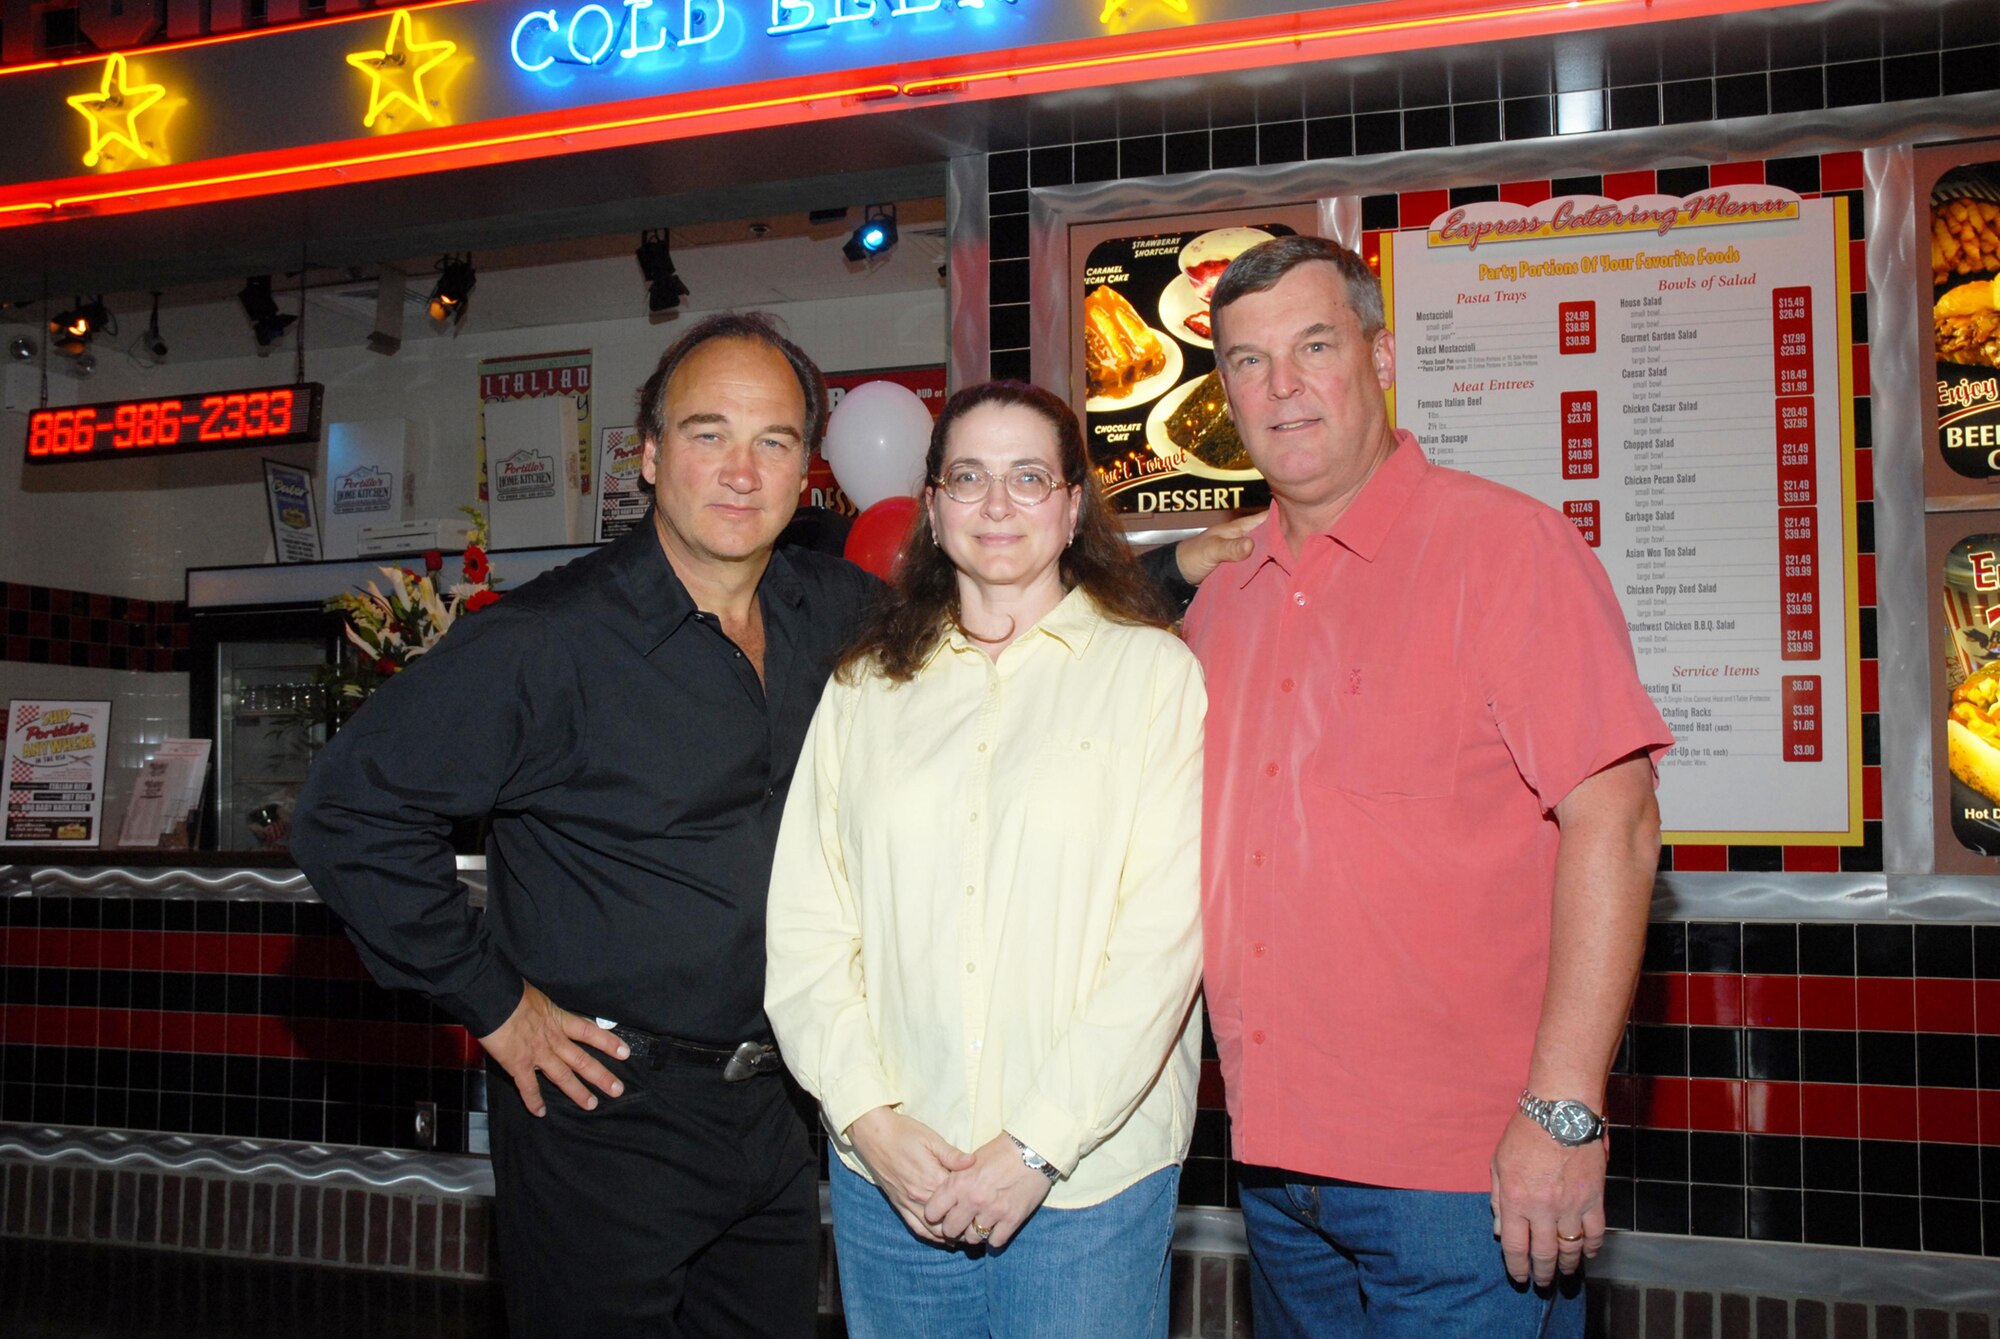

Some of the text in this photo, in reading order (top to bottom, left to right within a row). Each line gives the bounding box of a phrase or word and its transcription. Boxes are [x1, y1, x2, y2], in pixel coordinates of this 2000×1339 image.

[510, 0, 726, 72] COLD
[1440, 192, 1788, 251] Express Catering Menu
[1132, 237, 1182, 250] STRAWBERRY
[1134, 246, 1180, 258] SHORTCAKE
[1479, 246, 1740, 281] Party Portions Of Your Favorite Foods
[1086, 266, 1122, 276] CARAMEL
[1108, 274, 1130, 284] CAKE
[1658, 273, 1756, 292] Bowls of Salad
[1456, 290, 1527, 304] Pasta Trays
[1620, 296, 1662, 308] House Salad
[1779, 297, 1804, 308] $15.49
[1416, 310, 1453, 321] Mostaccioli
[1565, 311, 1590, 322] $24.99
[1779, 308, 1804, 320] $26.49
[1565, 322, 1590, 332] $38.99
[1566, 336, 1590, 346] $30.99
[1621, 330, 1697, 344] Gourmet Garden Salad
[1782, 333, 1806, 344] $17.99
[1416, 344, 1476, 355] Baked Mostaccioli
[1780, 345, 1806, 356] $29.99
[1622, 367, 1667, 379] Caesar Salad
[1782, 369, 1806, 380] $18.49
[1452, 379, 1534, 393] Meat Entrees
[1782, 382, 1807, 392] $31.99
[1937, 378, 1998, 407] Enjoy
[1418, 396, 1482, 408] Famous Italian Beef
[1572, 402, 1592, 412] $9.49
[1623, 401, 1698, 414] Chicken Caesar Salad
[1567, 412, 1592, 424] $23.70
[1782, 407, 1807, 418] $20.49
[29, 389, 293, 457] 866-986-2333
[1094, 423, 1142, 434] CHOCOLATE
[1784, 418, 1808, 429] $37.99
[1107, 432, 1130, 442] CAKE
[1418, 434, 1468, 444] Italian Sausage
[1568, 438, 1592, 449] $21.99
[1624, 438, 1674, 450] Chopped Salad
[1782, 444, 1808, 454] $21.49
[1568, 450, 1592, 460] $40.99
[1782, 455, 1808, 466] $39.99
[1134, 448, 1188, 476] Forget
[504, 462, 545, 474] Portillo's
[1568, 464, 1592, 474] $21.99
[520, 472, 552, 484] KITCHEN
[1624, 473, 1696, 486] Chicken Pecan Salad
[1784, 480, 1809, 490] $21.49
[358, 487, 389, 498] KITCHEN
[1784, 492, 1810, 502] $39.99
[1138, 487, 1244, 513] DESSERT
[1570, 502, 1592, 514] $17.49
[1625, 510, 1674, 522] Garbage Salad
[1784, 517, 1810, 528] $21.49
[1784, 529, 1810, 540] $39.99
[1626, 546, 1696, 558] Asian Won Ton Salad
[1785, 554, 1811, 565] $21.49
[1786, 566, 1812, 576] $39.99
[1626, 584, 1717, 596] Chicken Poppy Seed Salad
[1786, 592, 1812, 603] $21.49
[1786, 604, 1812, 615] $39.99
[1628, 620, 1735, 632] Southwest Chicken B.B.Q. Salad
[1787, 630, 1812, 640] $21.49
[1787, 642, 1813, 652] $39.99
[1672, 664, 1760, 678] Service Items
[1672, 684, 1682, 693] Kit
[1792, 680, 1813, 691] $6.00
[1662, 708, 1712, 718] Chafing Racks
[1793, 705, 1814, 716] $3.99
[42, 708, 72, 726] SHIP
[1696, 722, 1712, 732] Heat
[1793, 720, 1814, 731] $1.09
[26, 722, 89, 741] Portillo's
[23, 734, 96, 758] ANYWHERE
[1794, 745, 1814, 756] $3.00
[1964, 808, 1989, 820] Hot
